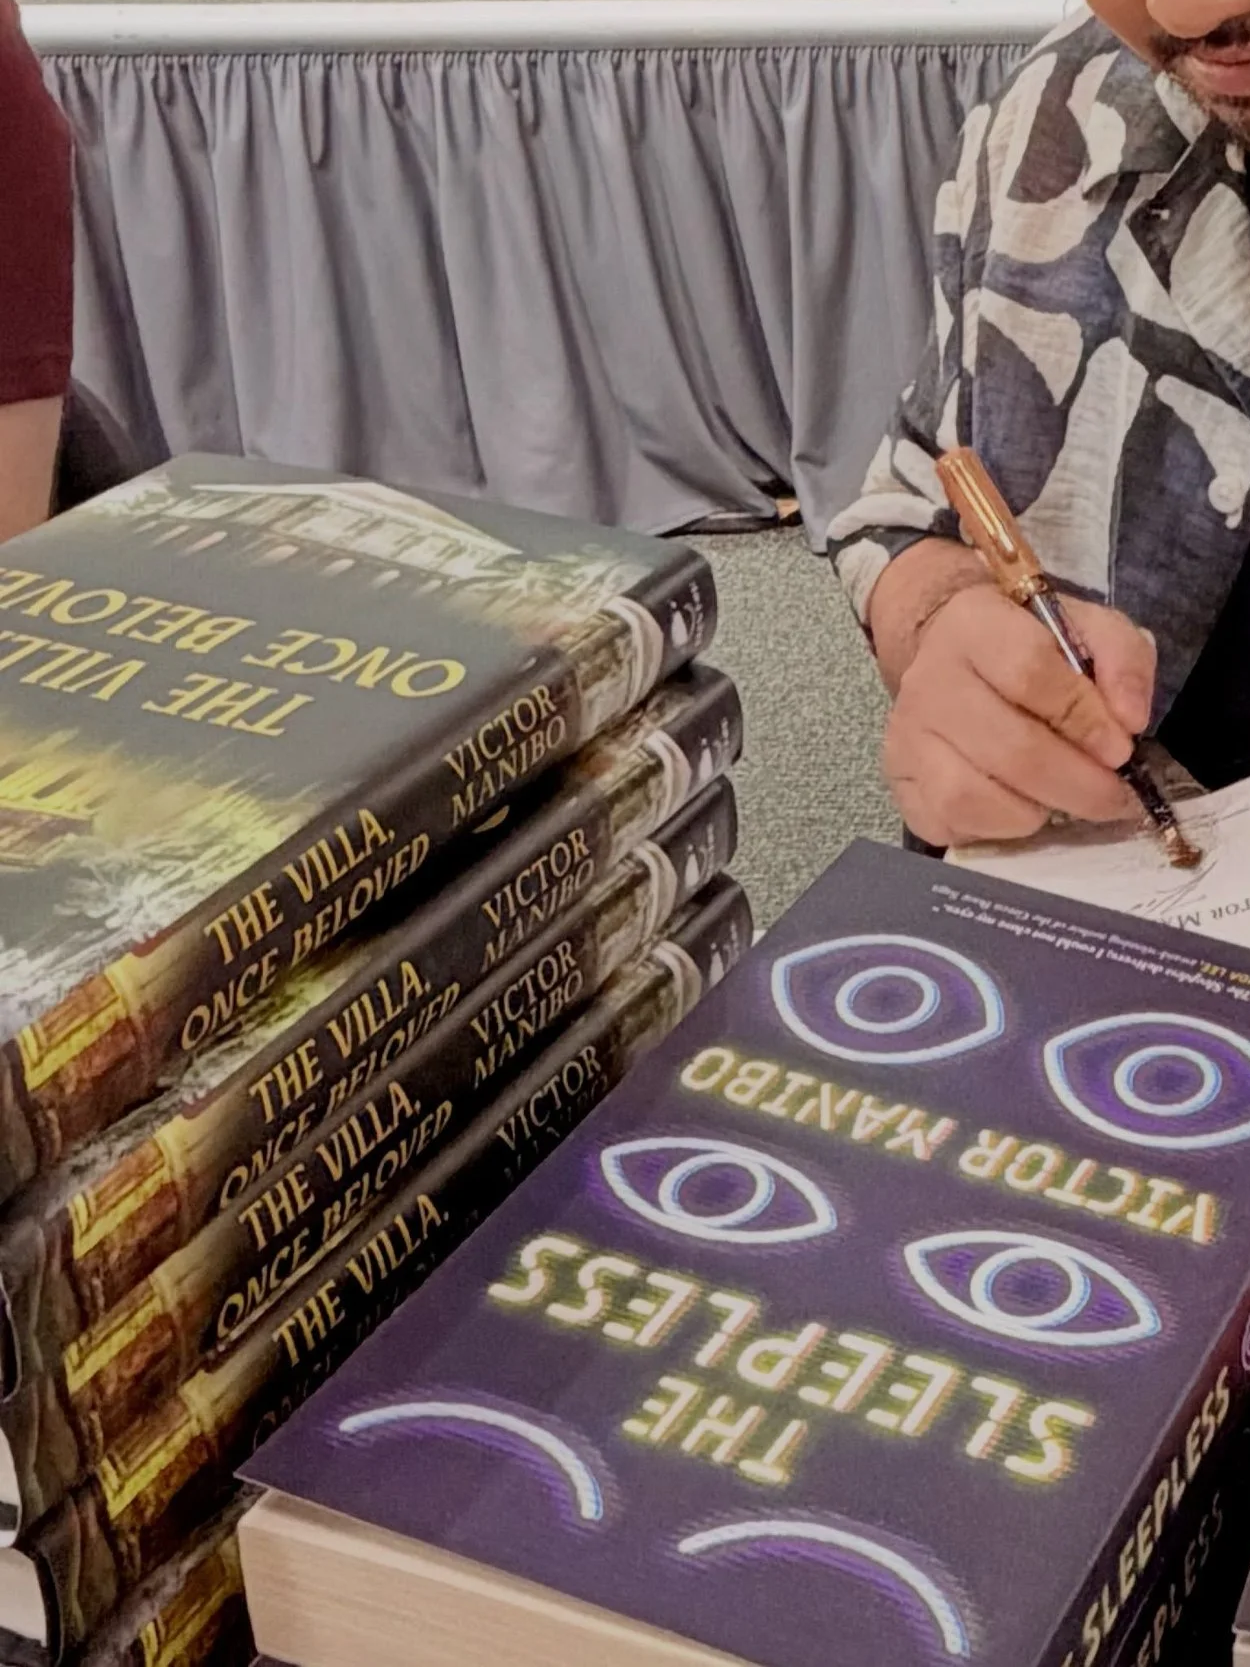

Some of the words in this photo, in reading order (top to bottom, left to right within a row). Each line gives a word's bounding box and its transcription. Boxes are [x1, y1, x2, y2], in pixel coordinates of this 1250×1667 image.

[142, 673, 314, 736] THE
[241, 629, 466, 698] ONCE
[442, 685, 557, 780] VICTOR
[452, 715, 566, 827] MANIBO
[203, 880, 284, 965] THE
[283, 808, 396, 904] VILLA,
[481, 827, 591, 928] VICTOR
[481, 858, 595, 973] MANIBO
[180, 947, 279, 1051] ONCE
[290, 833, 430, 968] BELOVED
[470, 940, 578, 1045] VICTOR
[249, 1038, 324, 1124] THE
[474, 969, 584, 1091] MANIBO
[219, 1100, 316, 1210] ONCE
[325, 981, 460, 1118] BELOVED
[497, 1045, 602, 1154] VICTOR
[679, 1045, 968, 1161] MANIBO
[217, 1228, 311, 1338] ONCE
[322, 1100, 453, 1242] BELOVED
[239, 1164, 316, 1252] THE
[956, 1127, 1224, 1245] VICTOR
[273, 1279, 346, 1368] THE
[487, 1236, 1097, 1481] SLEEPLESS
[622, 1375, 810, 1485] THE
[1083, 1366, 1230, 1667] SLEEPLESS
